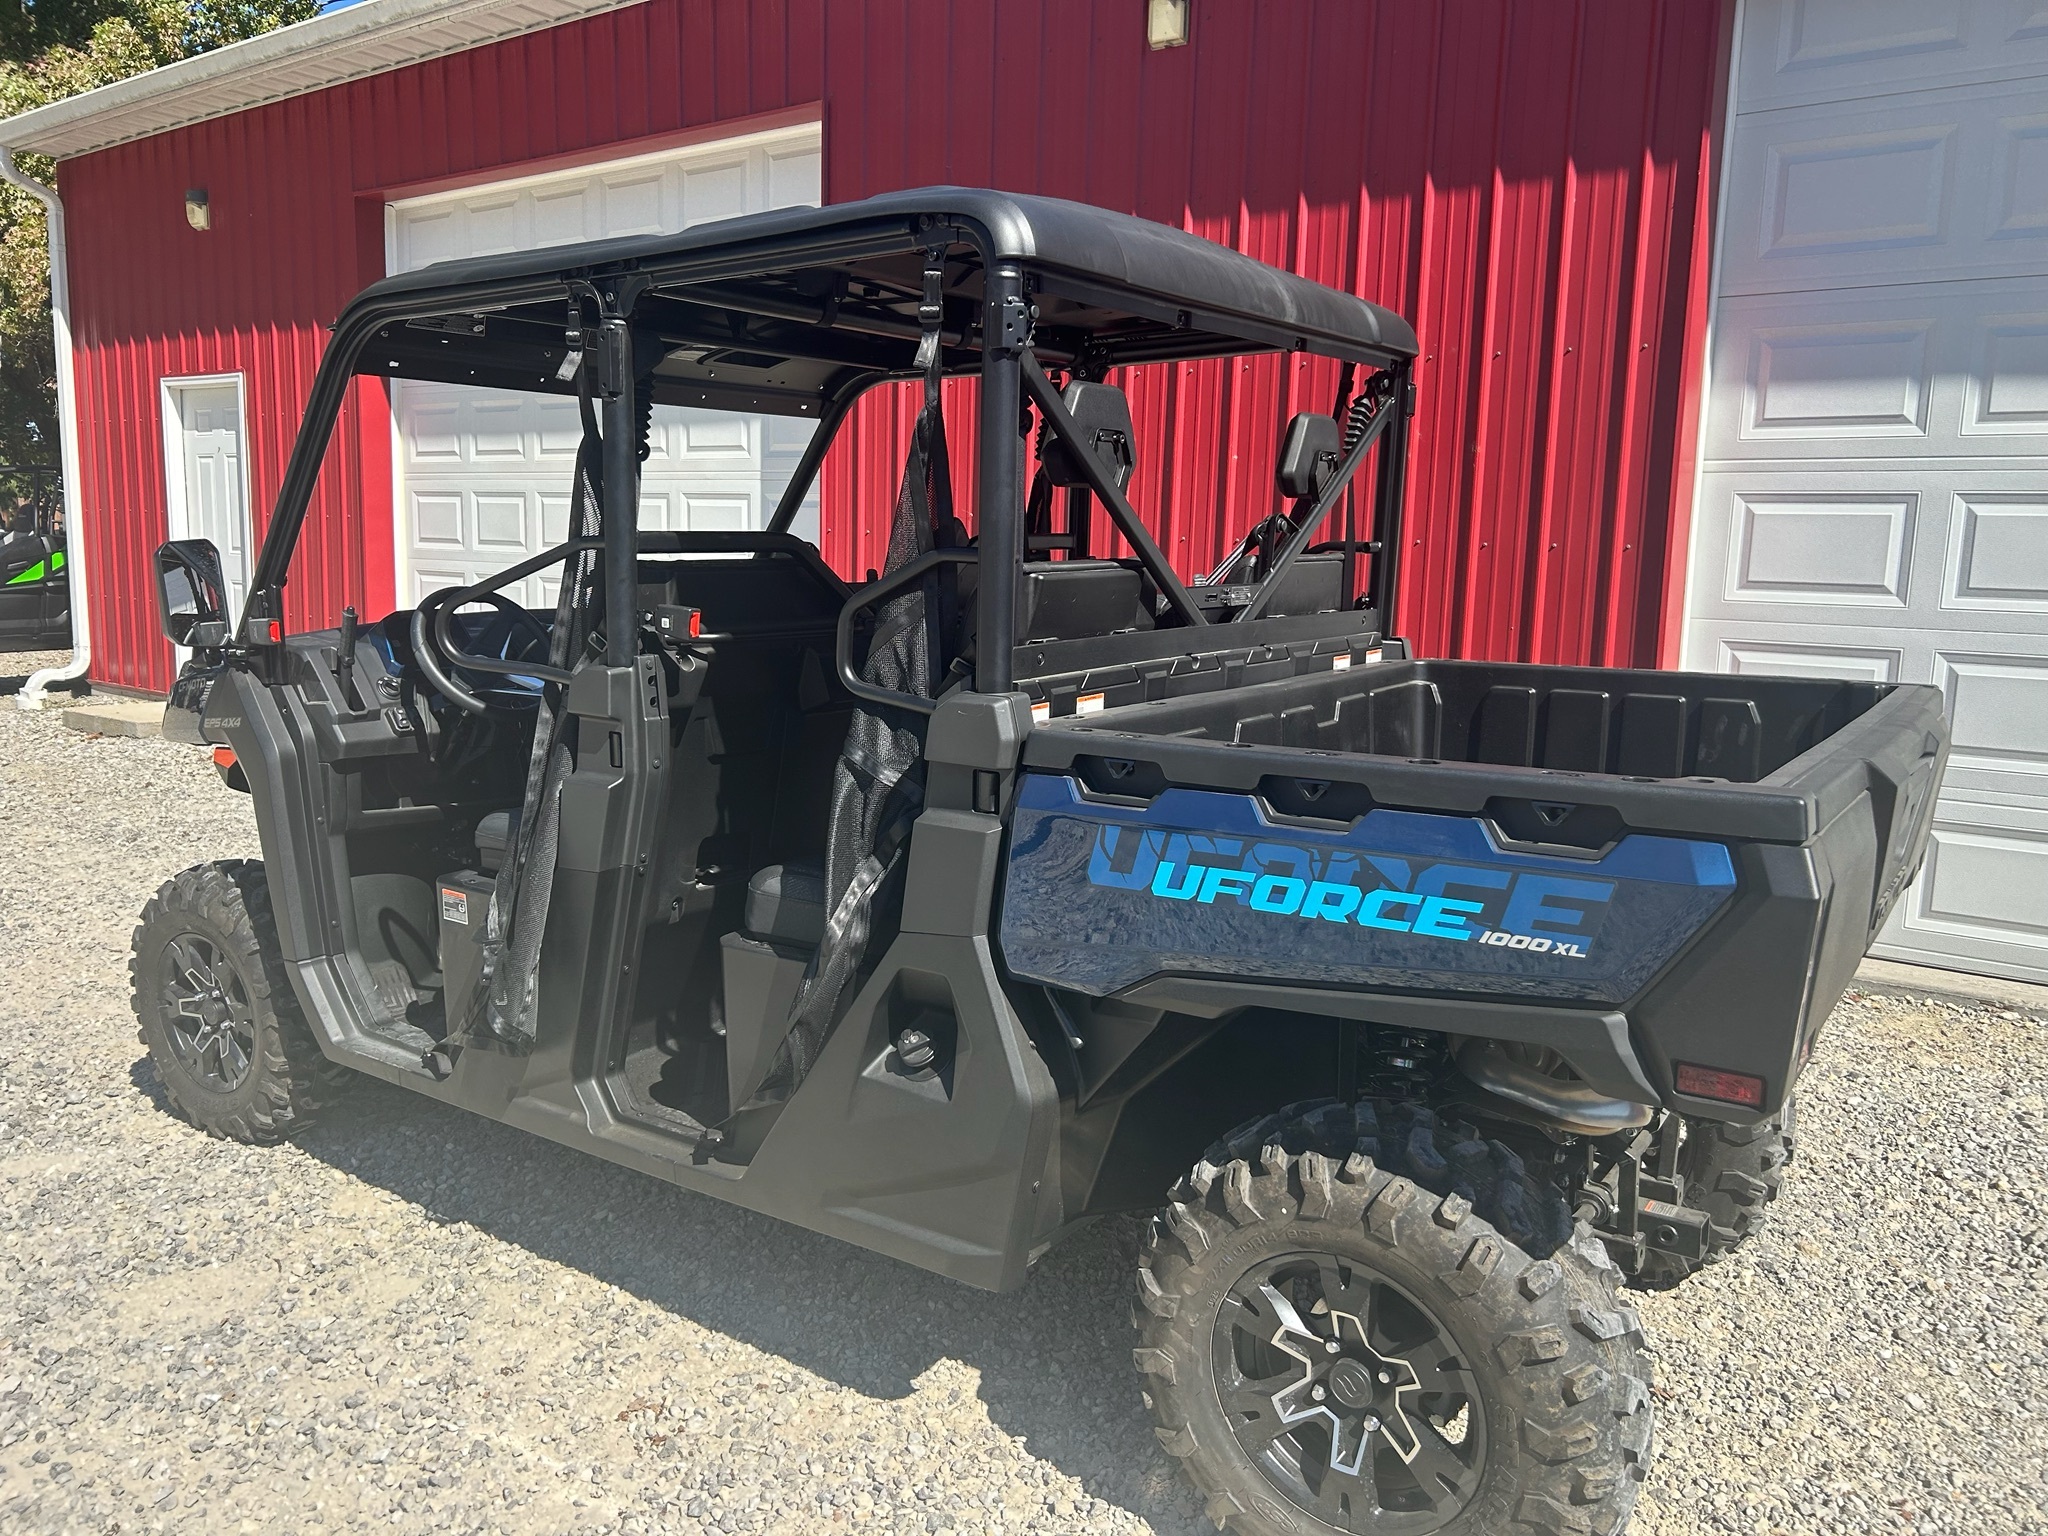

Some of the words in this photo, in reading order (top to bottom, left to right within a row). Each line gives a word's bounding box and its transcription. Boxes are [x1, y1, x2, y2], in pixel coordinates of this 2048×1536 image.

[204, 718, 221, 728] EPS
[222, 717, 241, 728] 4X4
[1151, 861, 1484, 941] UFORCE
[1478, 930, 1552, 953] 1000
[1552, 942, 1587, 958] XL
